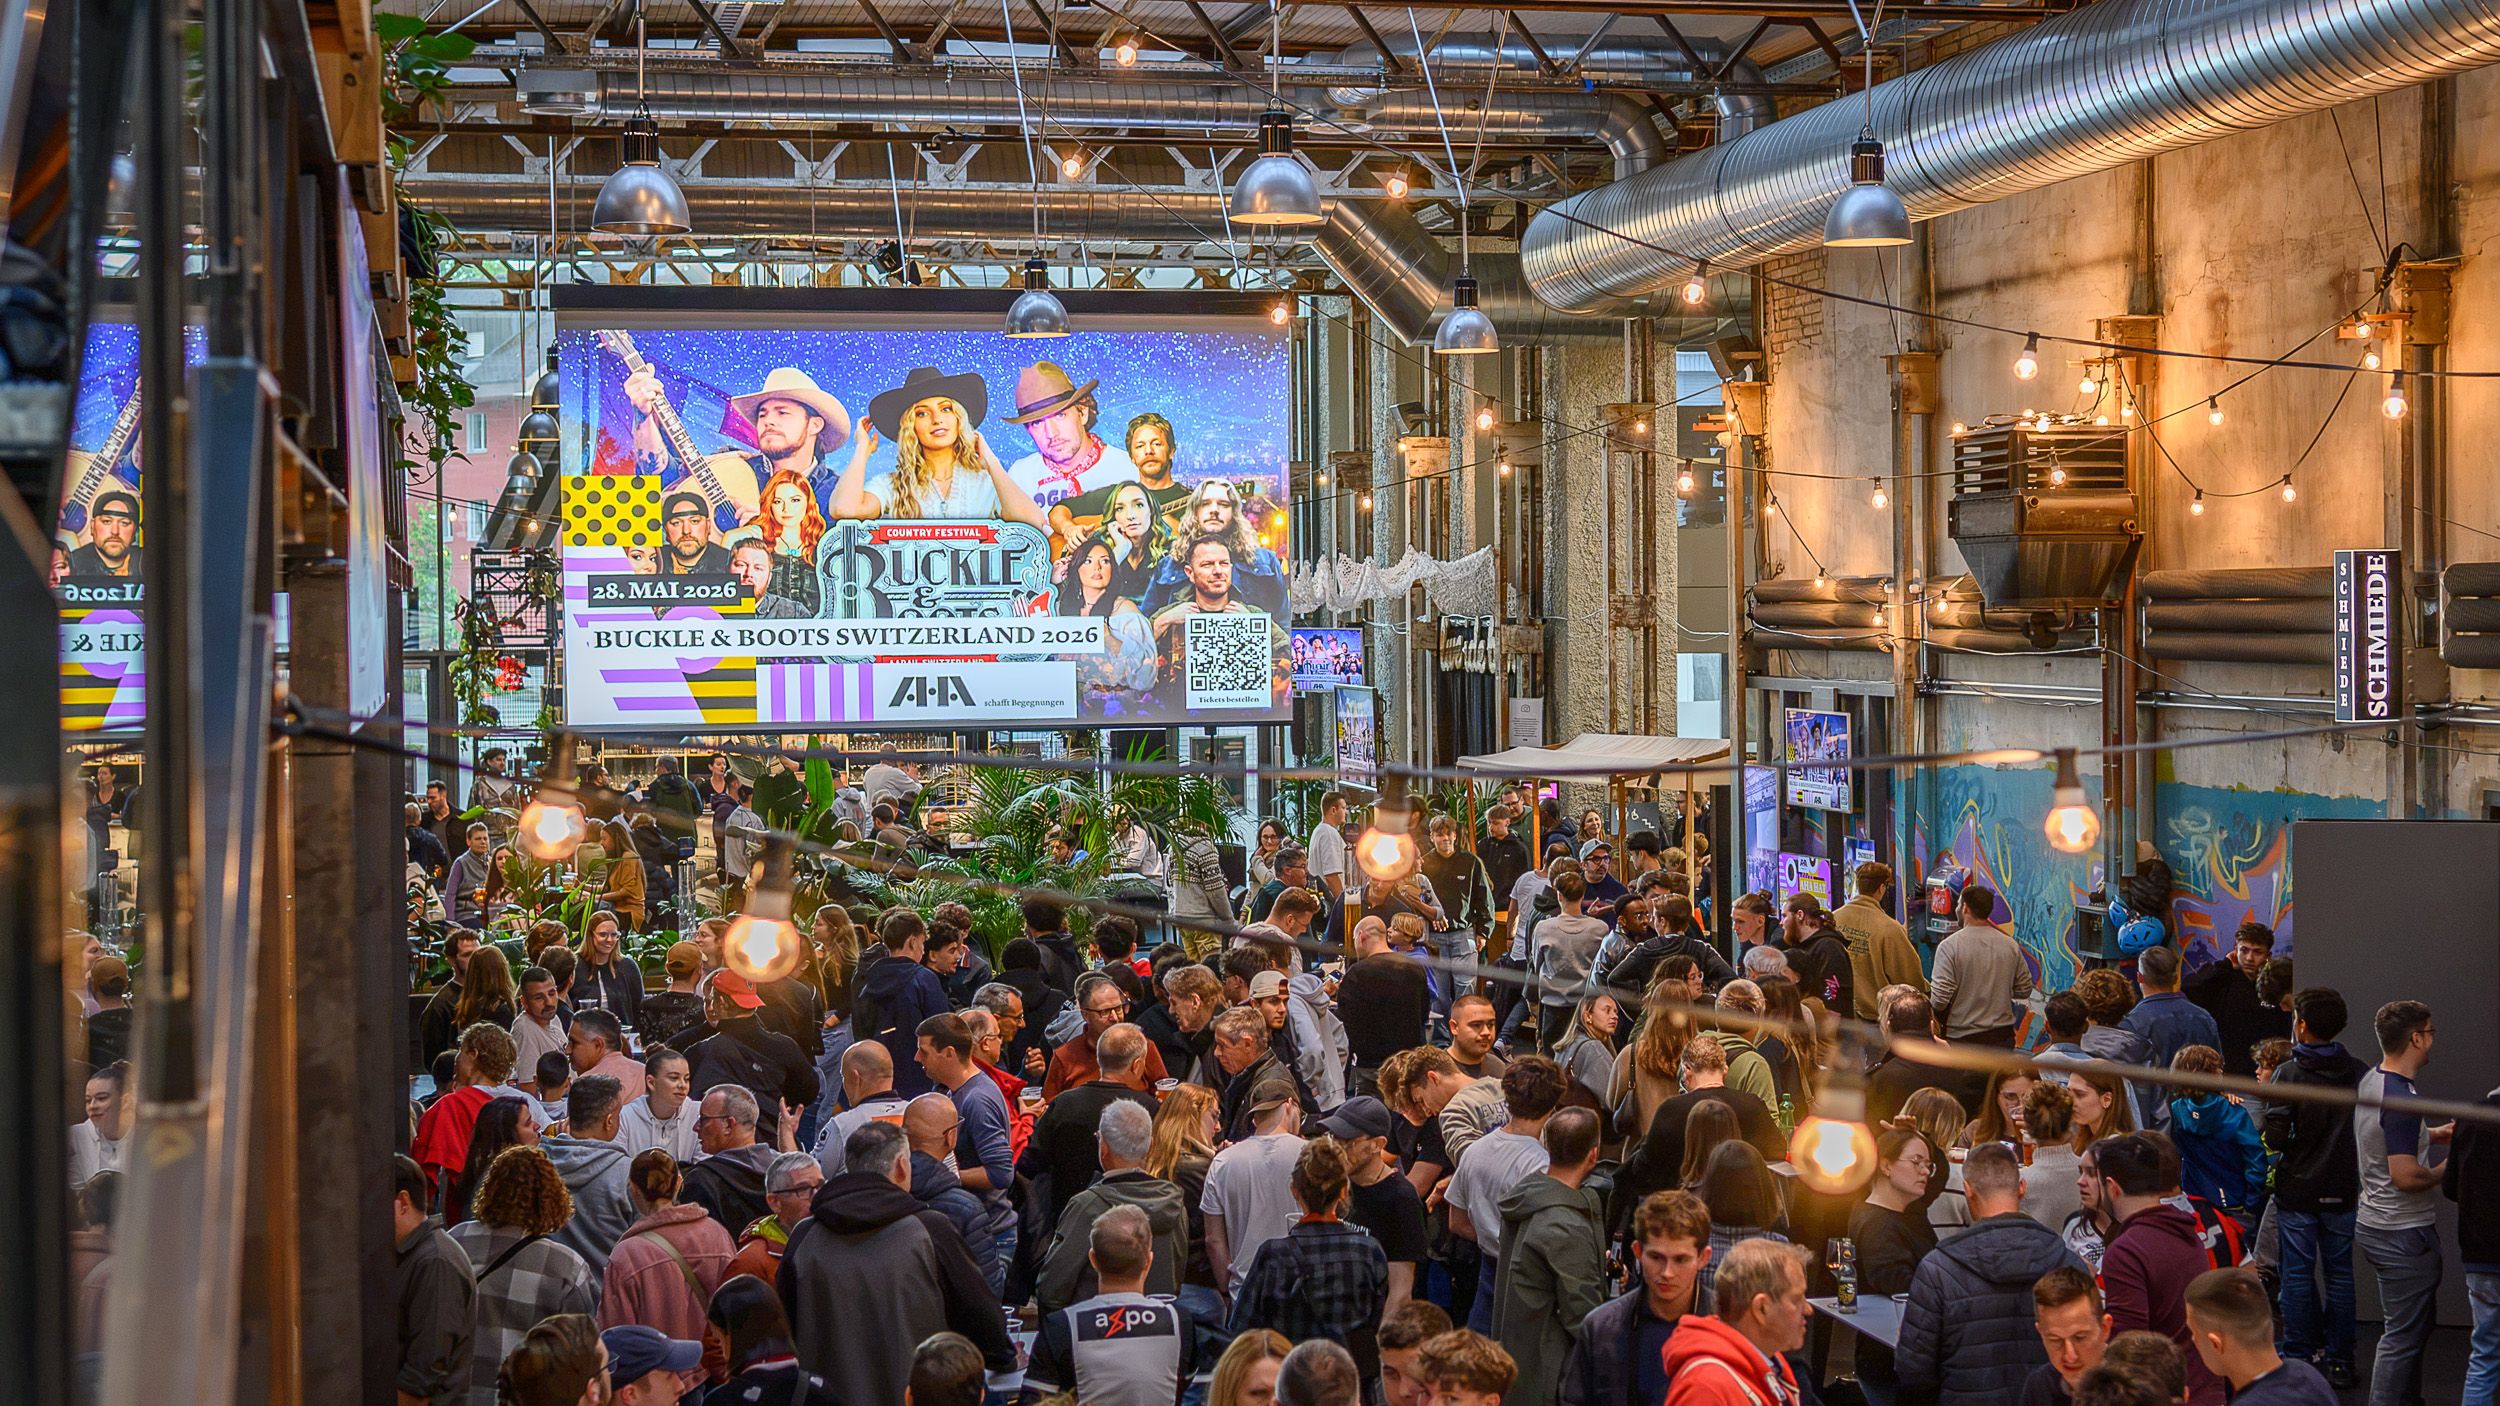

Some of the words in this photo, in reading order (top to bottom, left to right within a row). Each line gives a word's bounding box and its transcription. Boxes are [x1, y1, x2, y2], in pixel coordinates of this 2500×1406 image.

[886, 528, 931, 537] COUNTRY
[934, 527, 982, 537] FESTIVAL
[593, 583, 625, 600] 28.
[628, 581, 679, 599] MAI
[682, 581, 737, 599] 2026
[911, 586, 941, 608] &
[594, 629, 705, 649] BUCKLE
[711, 629, 731, 647] &
[737, 628, 829, 647] BOOTS
[835, 627, 1036, 646] SWITZERLAND
[1041, 625, 1098, 644] 2026
[2338, 562, 2349, 707] SCHMIEDE
[2367, 554, 2388, 717] SCHMIEDE
[888, 675, 977, 707] AHA
[984, 698, 1010, 707] schafft
[1011, 698, 1065, 710] Begegnungen
